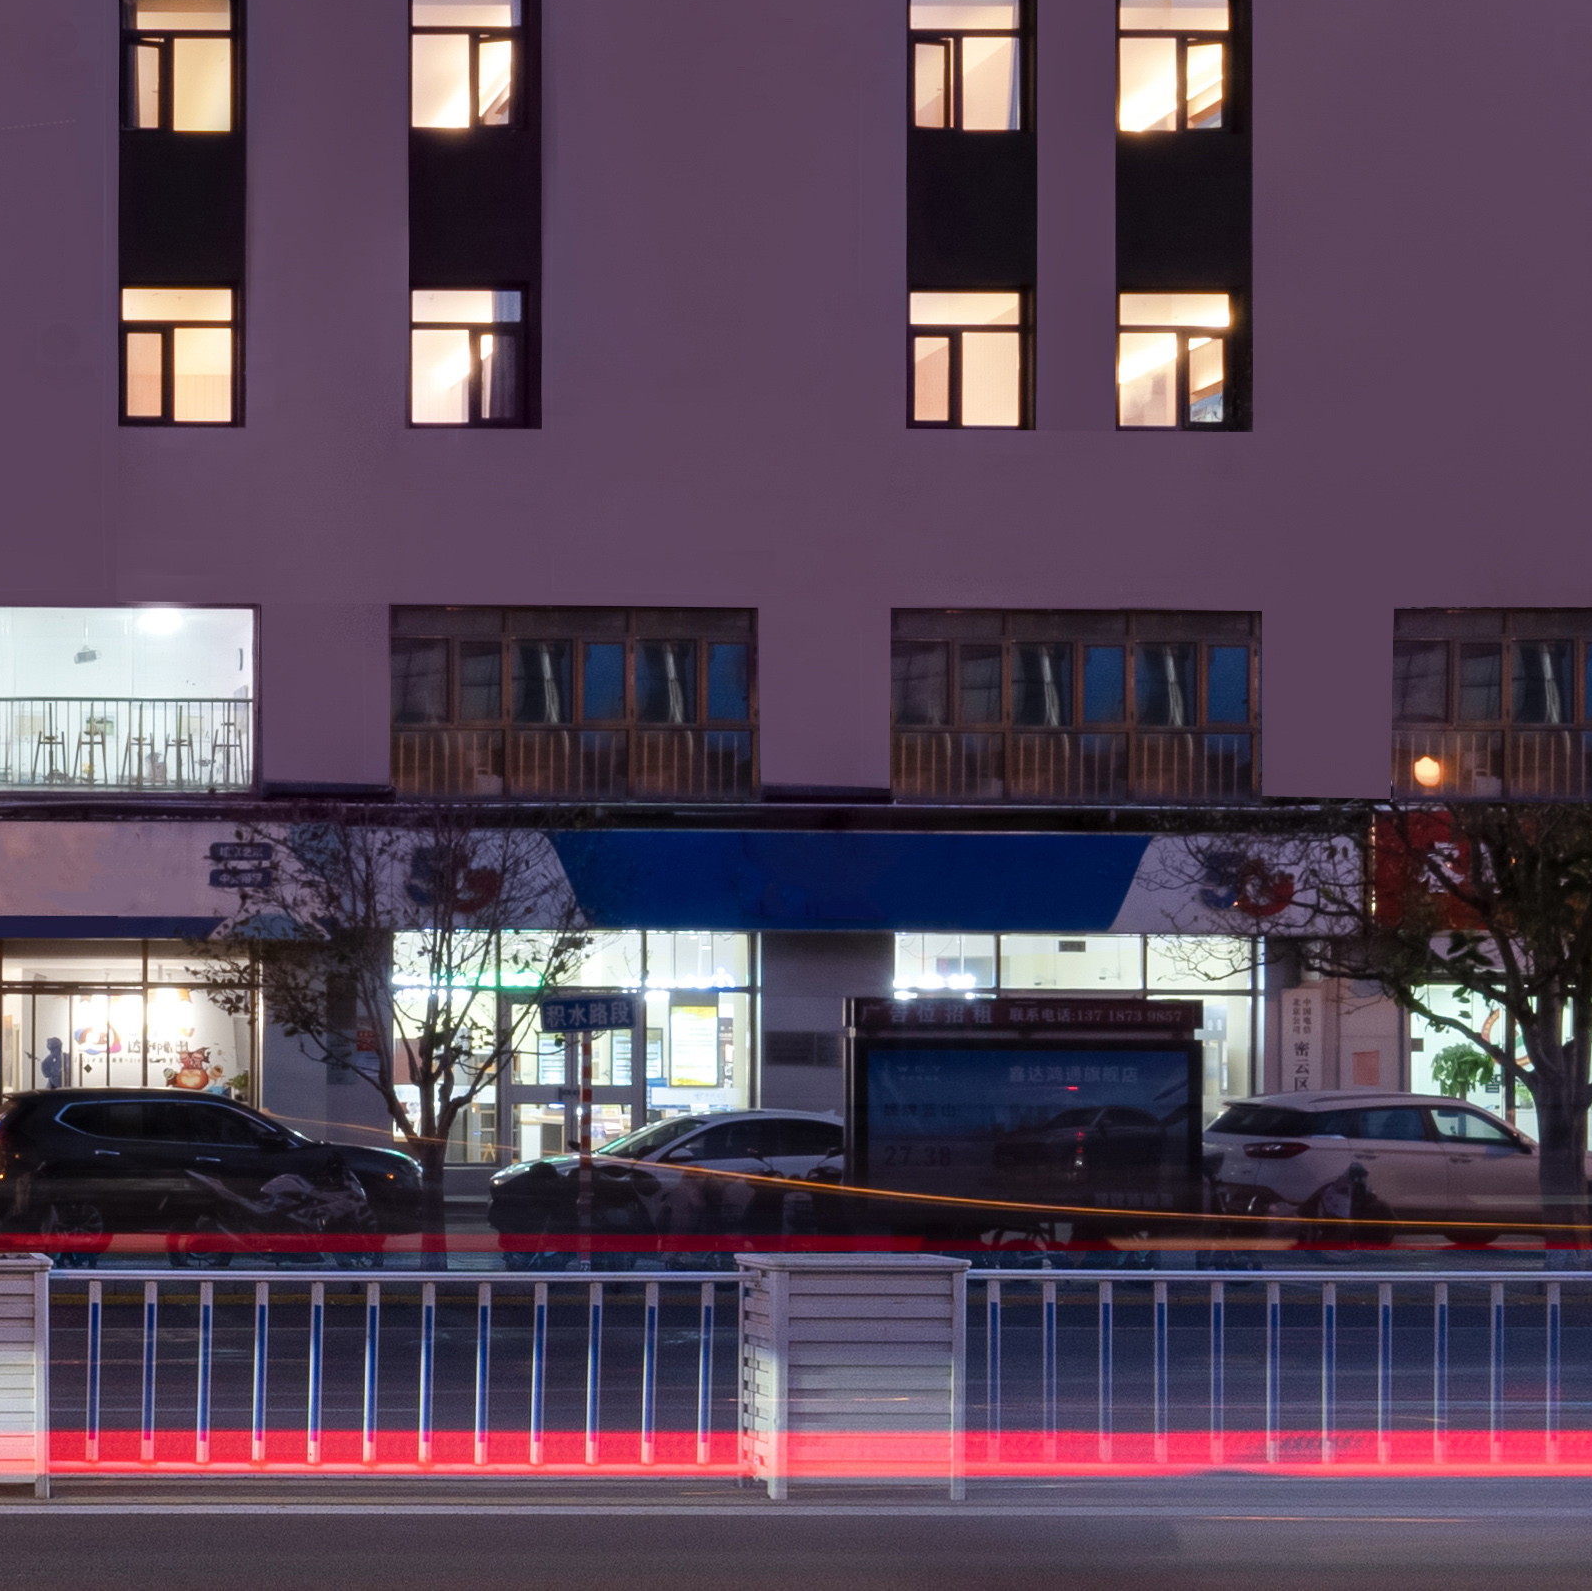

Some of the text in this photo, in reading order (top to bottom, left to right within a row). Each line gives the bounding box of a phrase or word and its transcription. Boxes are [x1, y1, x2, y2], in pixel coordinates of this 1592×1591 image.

[545, 1000, 631, 1028] 积水路段
[860, 1004, 994, 1024] 广告位招租
[1109, 1008, 1143, 1023] 1873
[1147, 1008, 1183, 1023] 9857
[1292, 997, 1301, 1034] 北京公司
[1302, 997, 1312, 1034] 中国电信
[1009, 1065, 1139, 1084] 鑫达鸿通旗舰店
[1294, 1040, 1310, 1091] 密云区
[883, 1145, 952, 1167] 27.38
